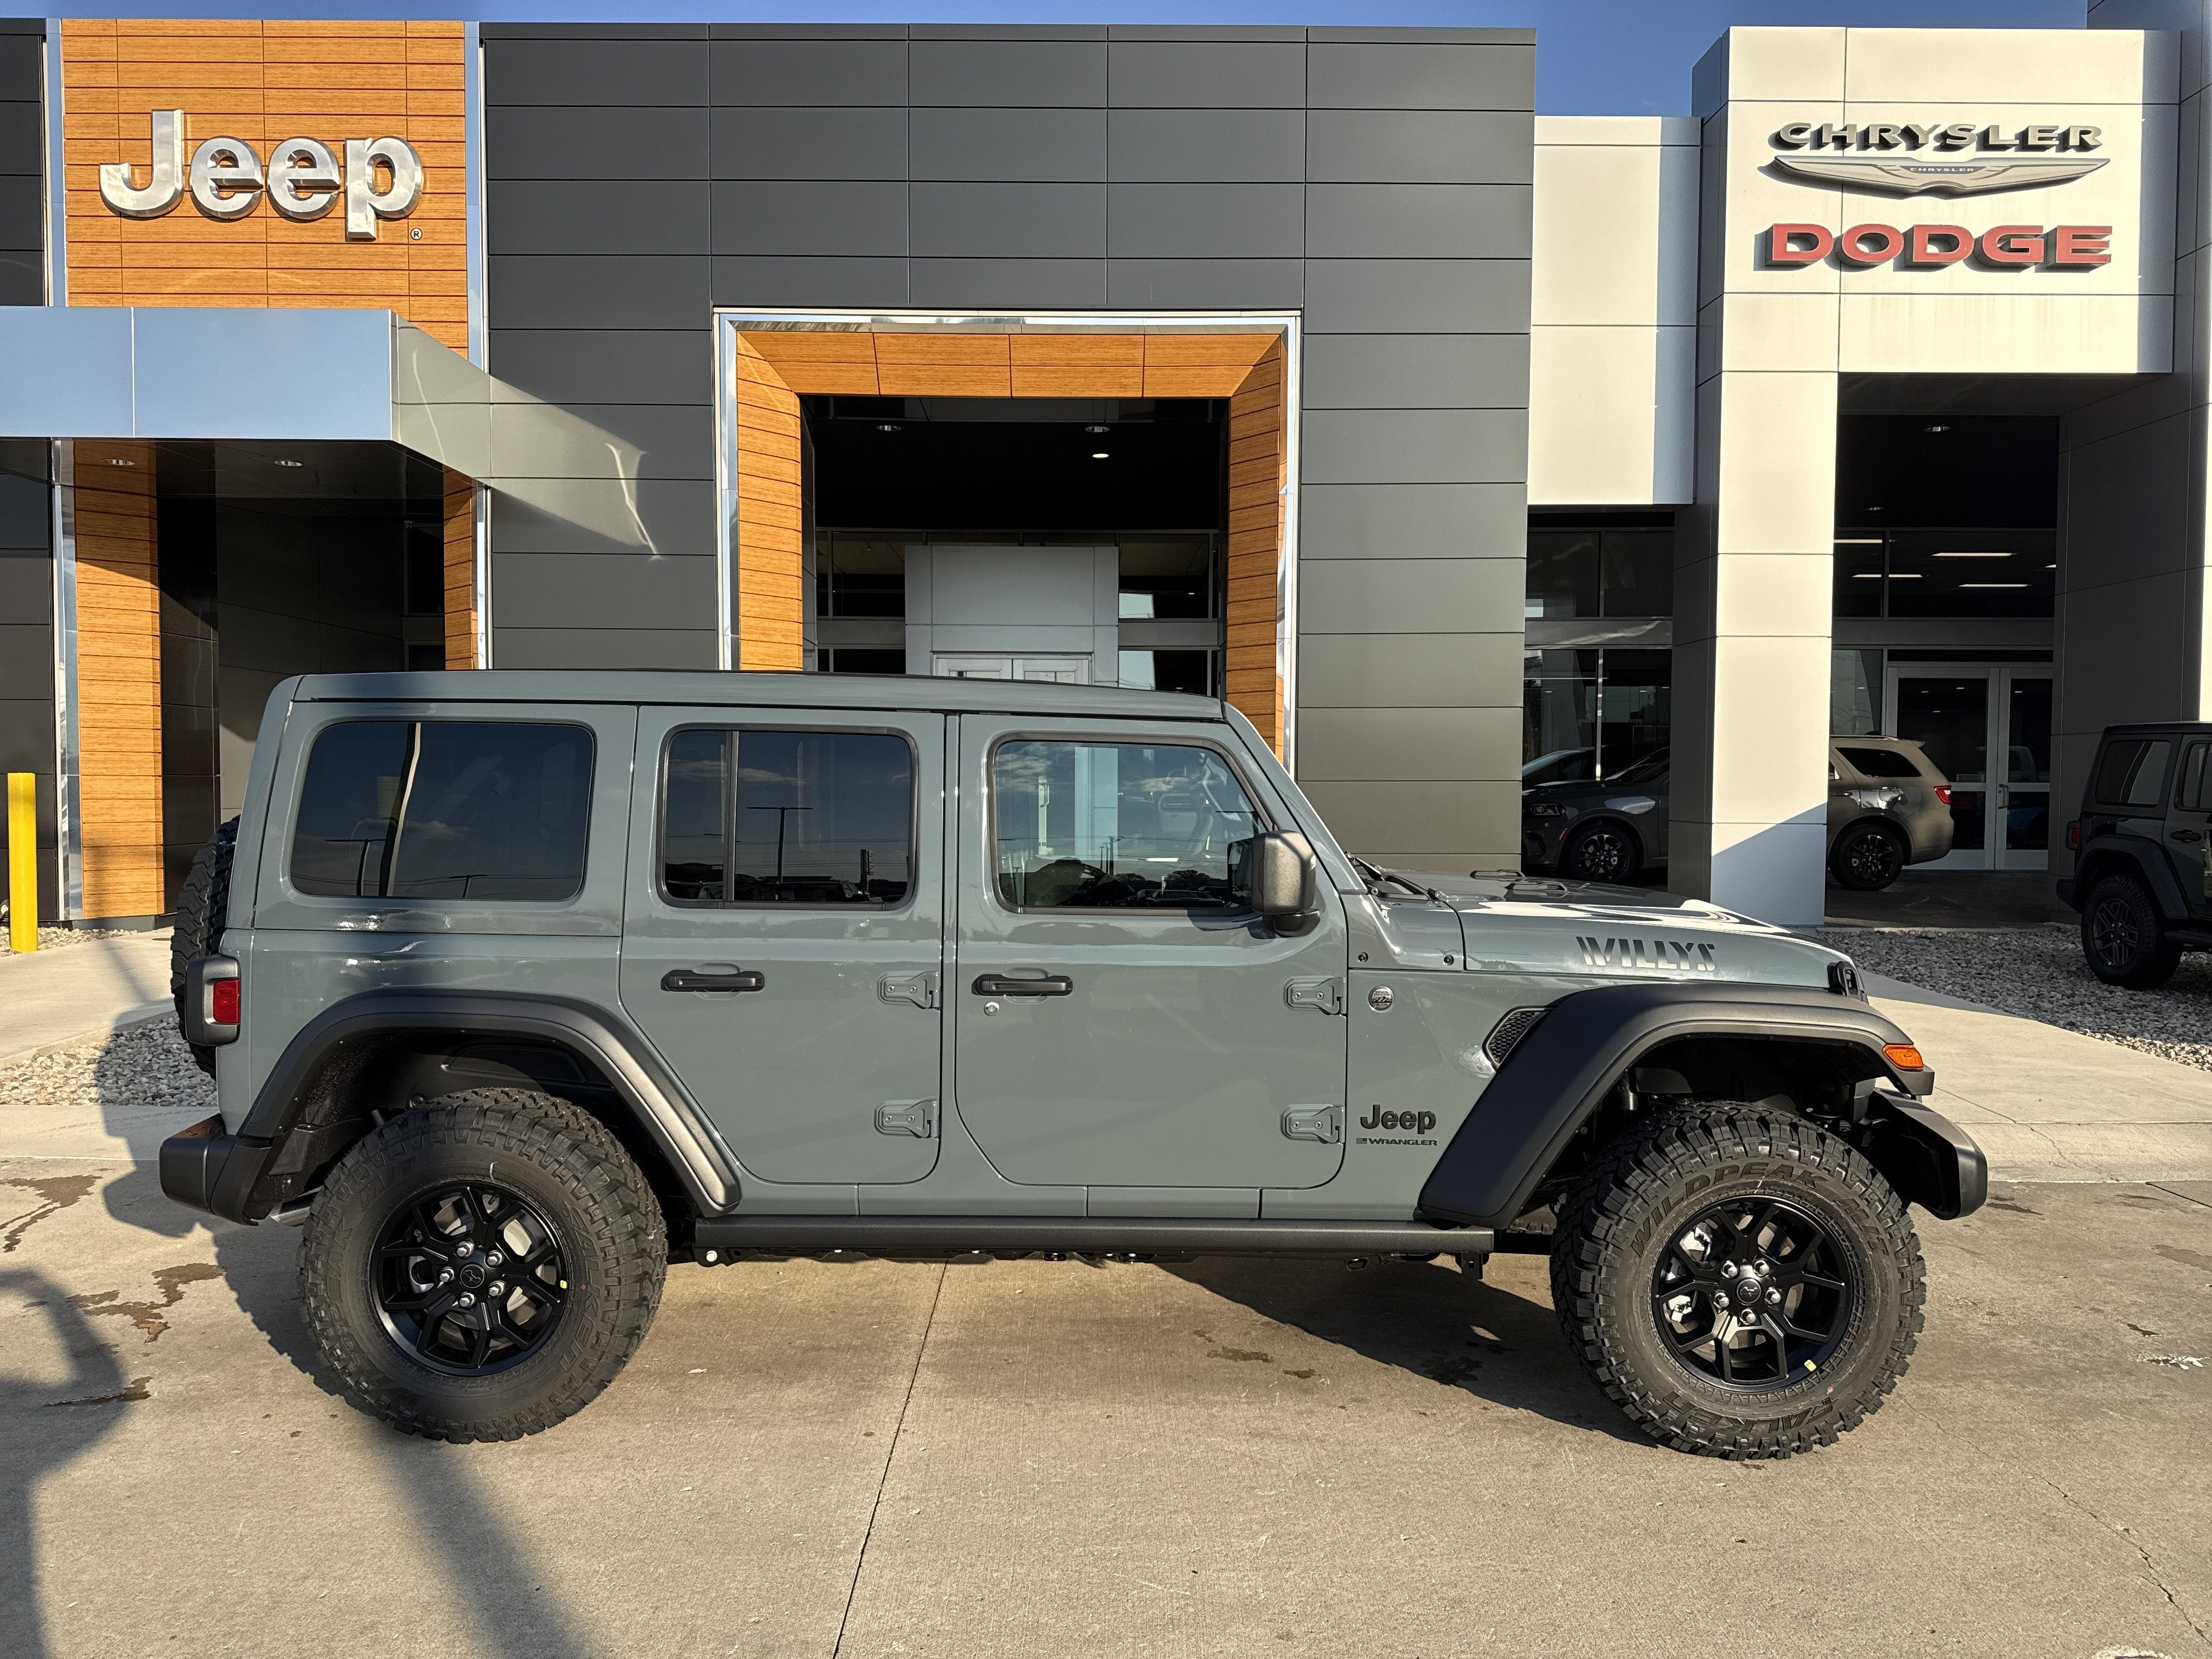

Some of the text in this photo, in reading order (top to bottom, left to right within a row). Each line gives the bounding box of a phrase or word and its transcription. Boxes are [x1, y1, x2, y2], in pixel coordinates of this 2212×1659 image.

[1776, 122, 2102, 147] CHRYSLER
[99, 109, 424, 240] Jeep
[1771, 223, 2112, 264] DODGE
[1576, 936, 1716, 971] WILLYS
[1360, 1104, 1436, 1134] Jeep
[1368, 1138, 1438, 1146] WRANGLER
[1630, 1162, 1828, 1257] WILDPEAK
[1663, 1391, 1839, 1433] FALKEN
